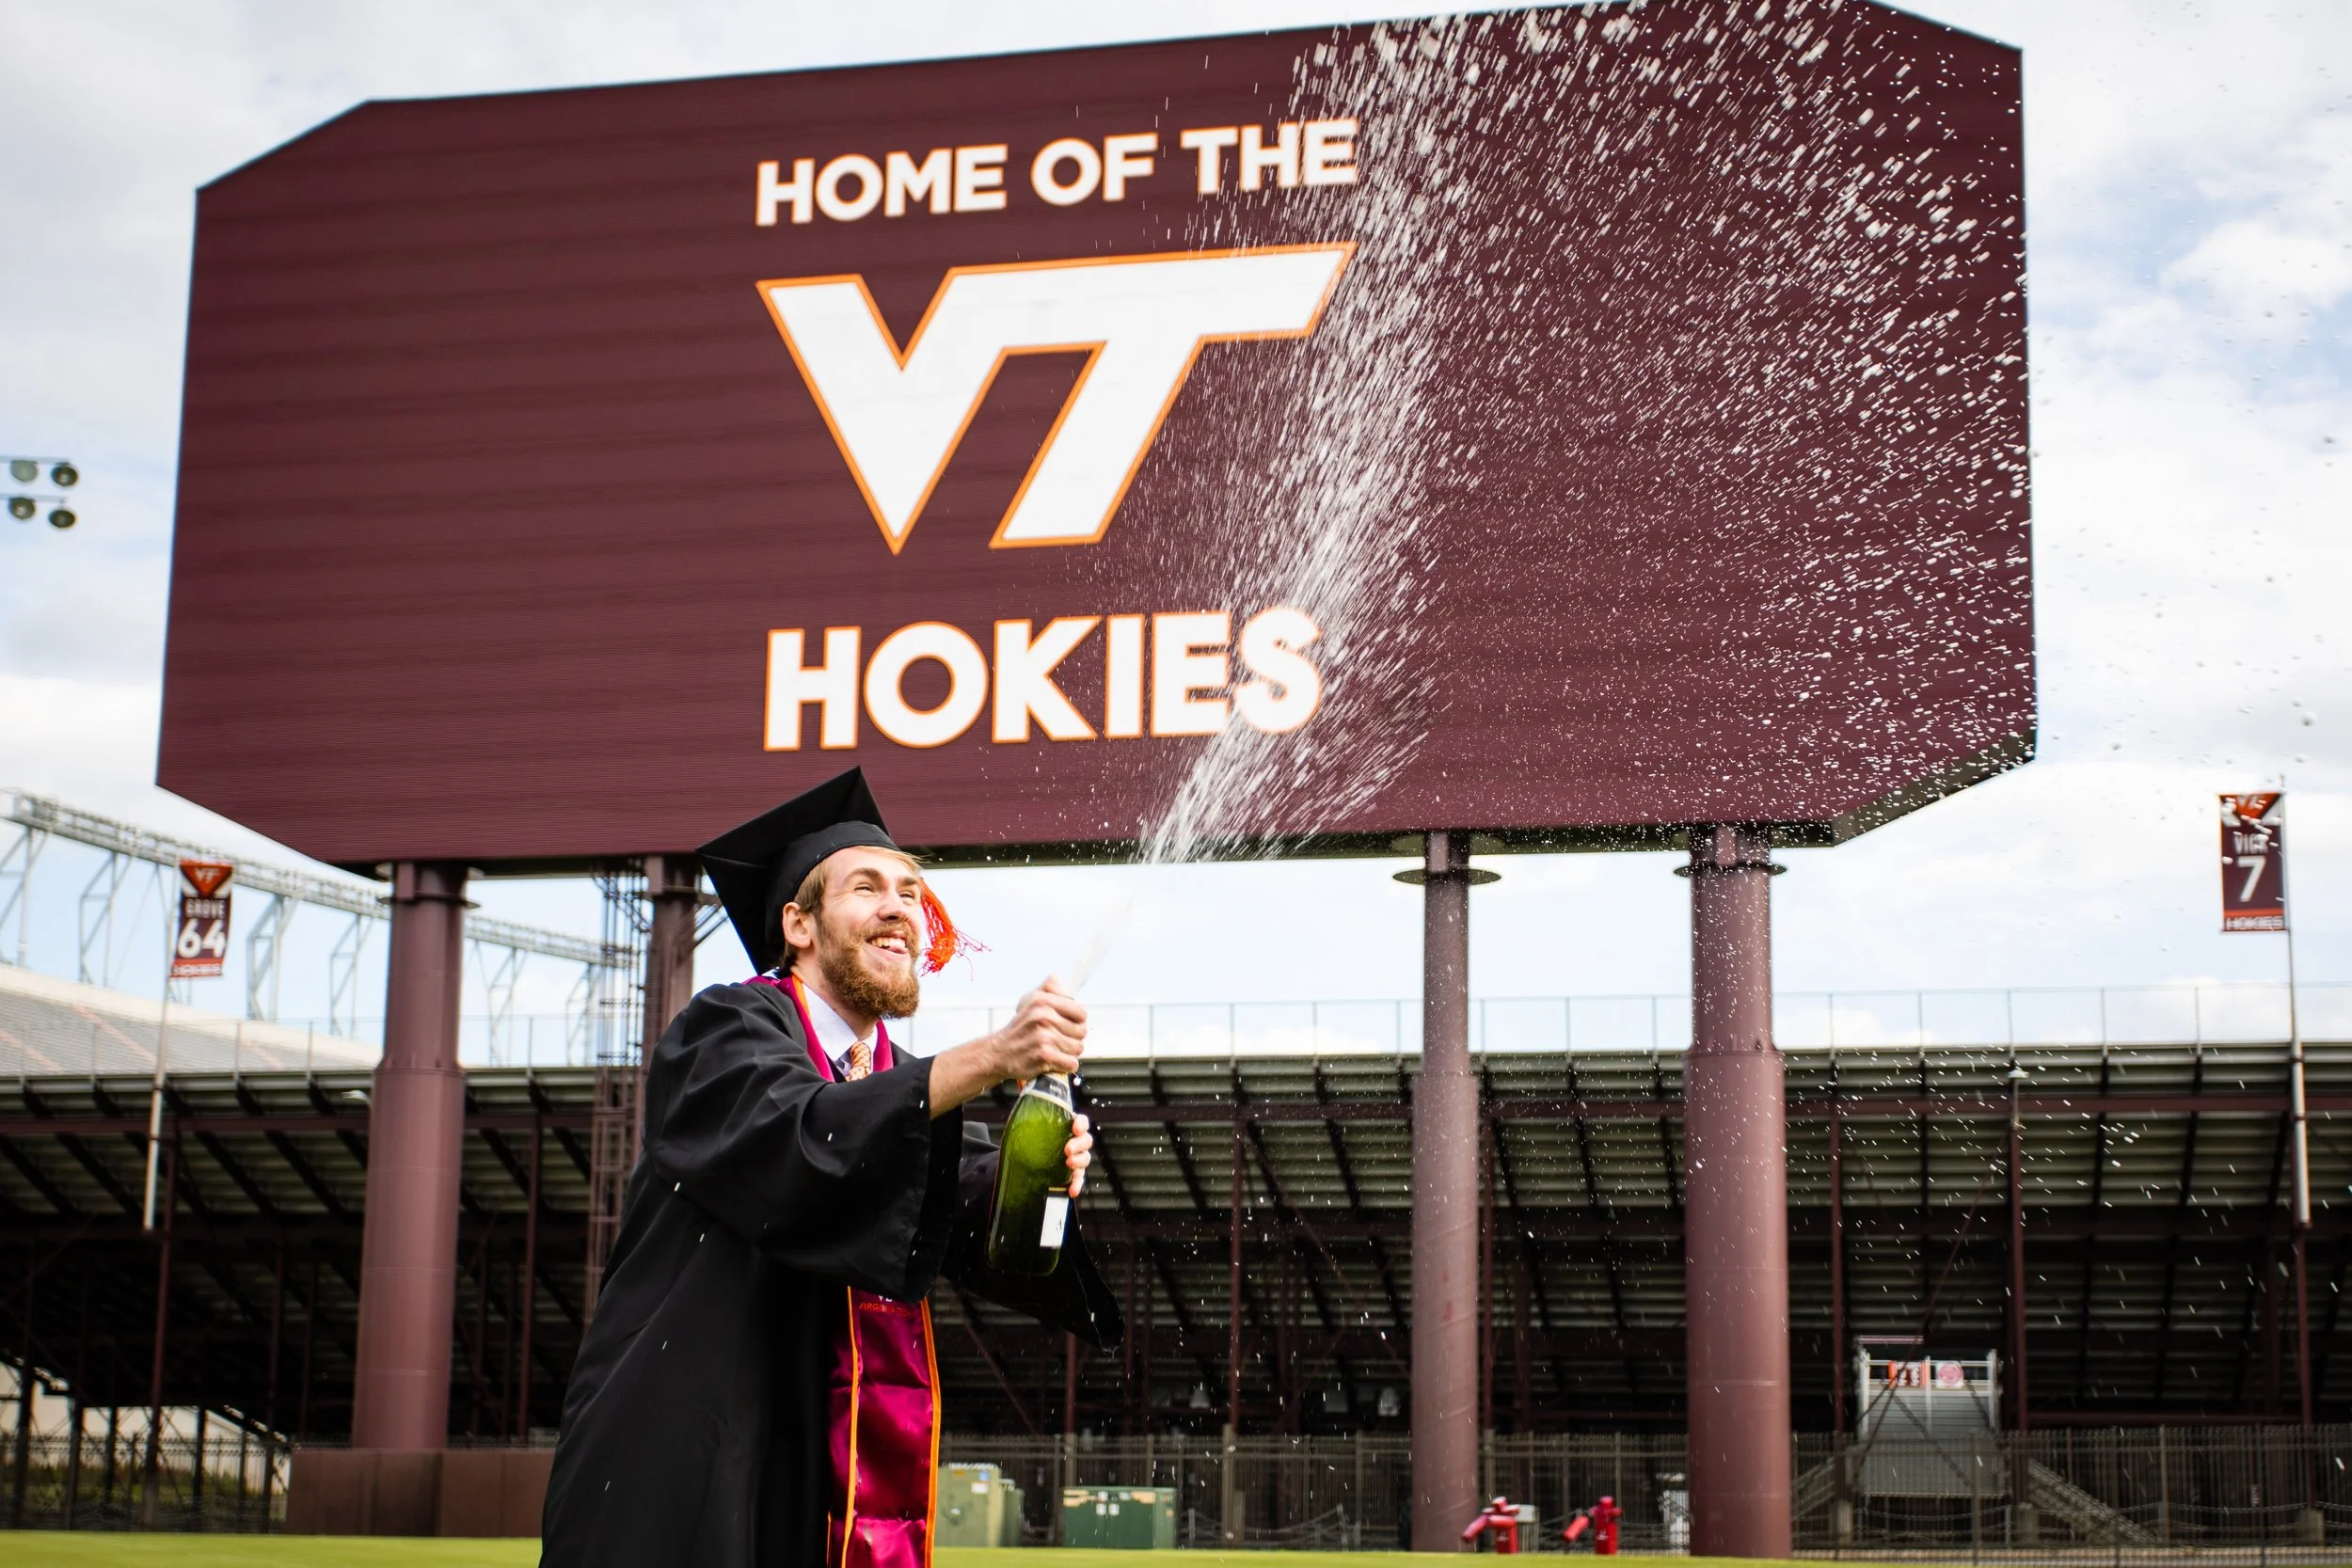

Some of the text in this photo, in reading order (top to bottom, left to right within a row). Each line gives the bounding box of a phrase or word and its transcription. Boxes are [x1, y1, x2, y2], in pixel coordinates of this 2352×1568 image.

[755, 118, 1359, 227] HOME OF THE
[755, 241, 1358, 555] VT
[763, 606, 1322, 752] HOKIES
[2237, 855, 2265, 903] 7
[178, 918, 226, 958] 64
[2226, 916, 2284, 931] HOKIES
